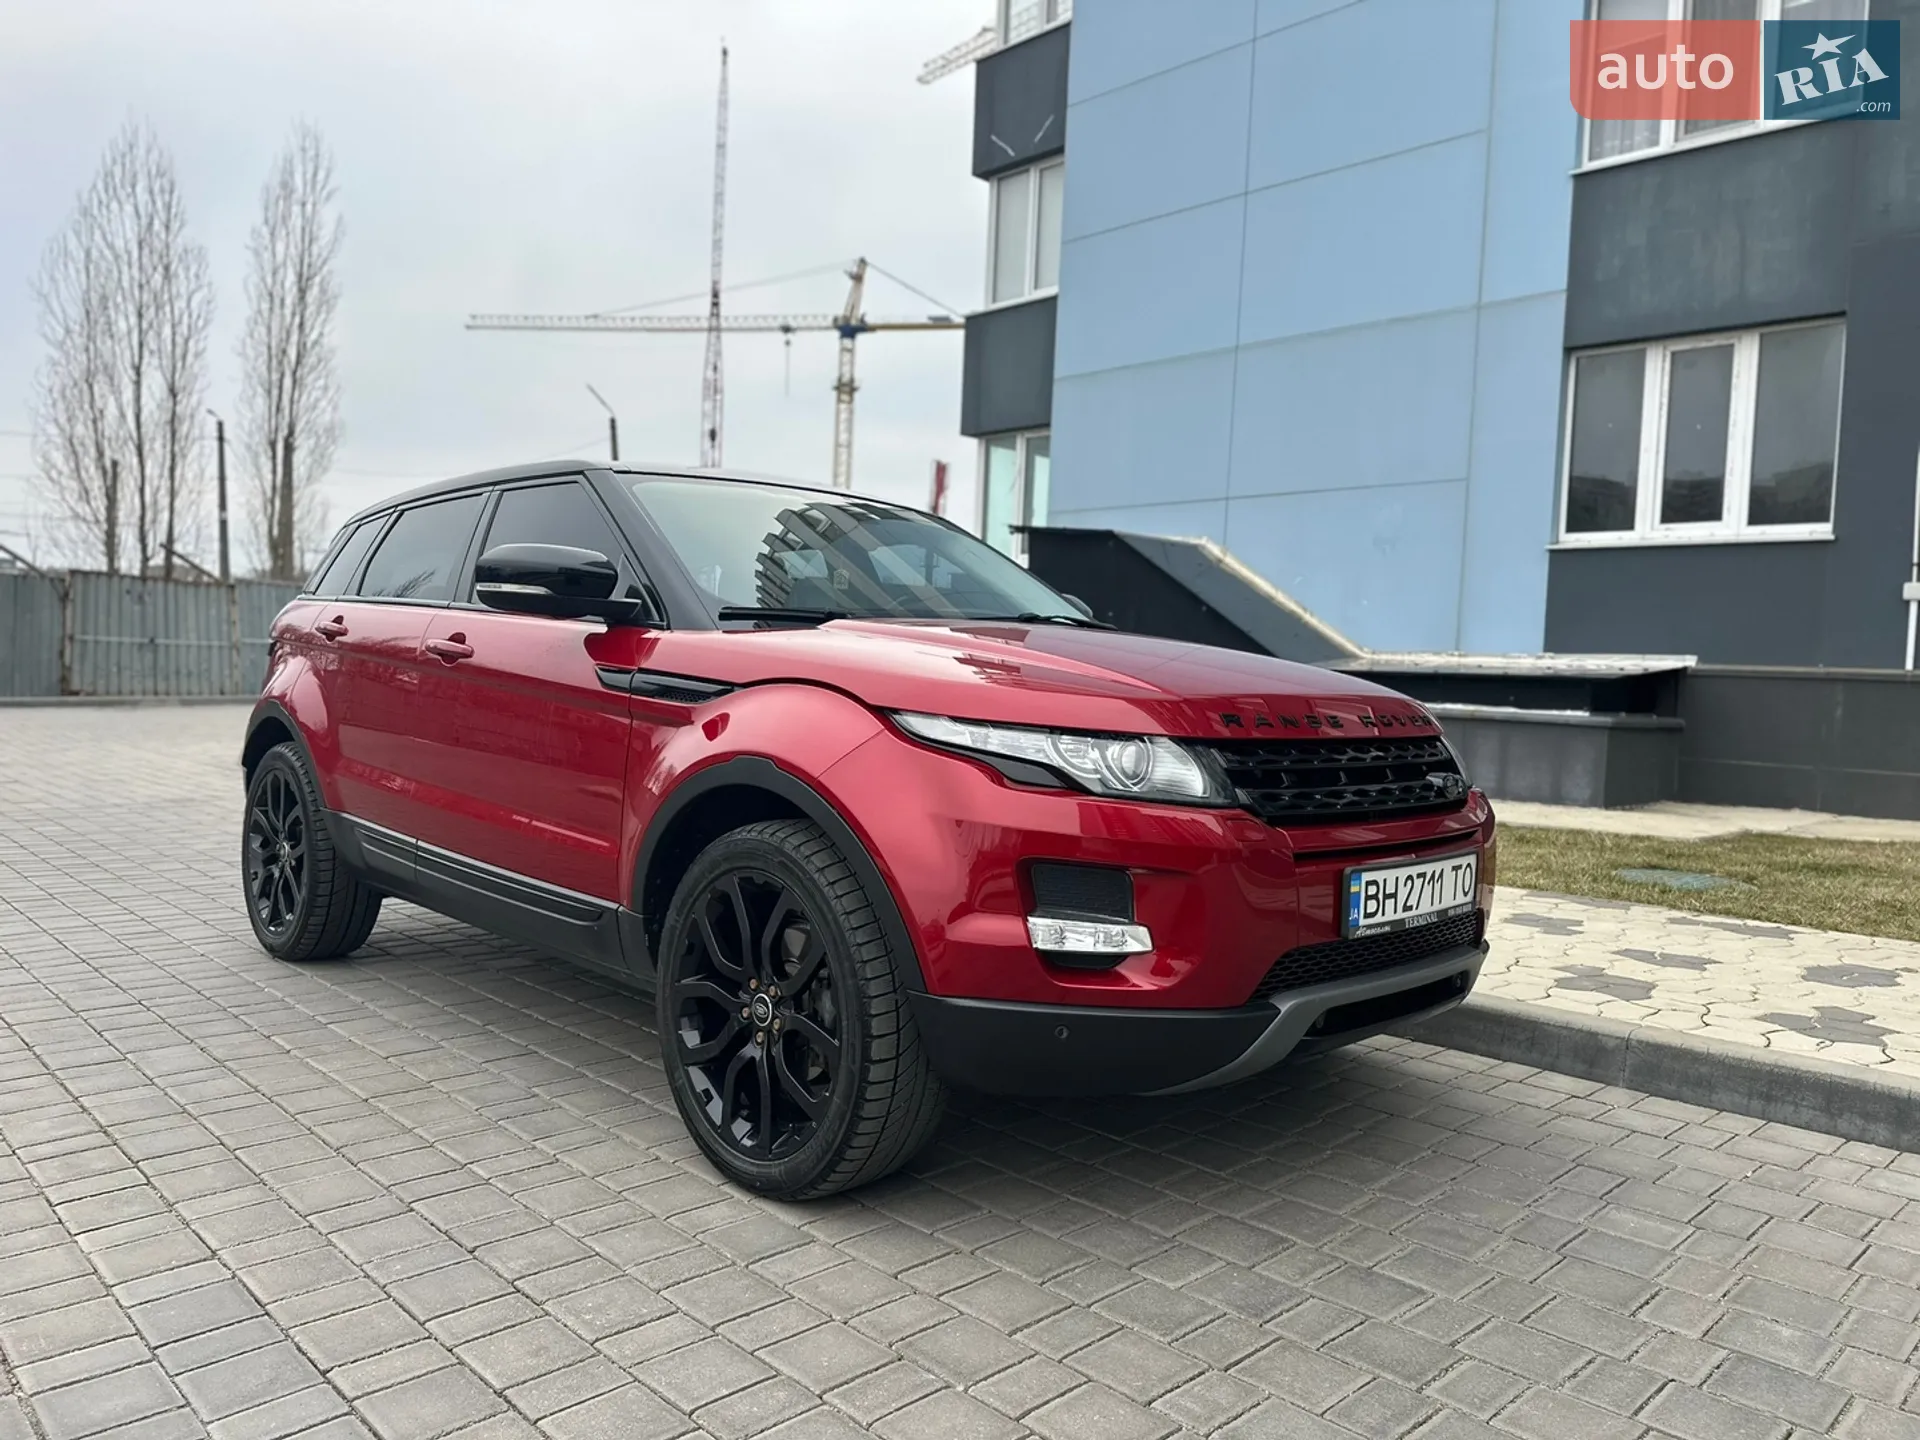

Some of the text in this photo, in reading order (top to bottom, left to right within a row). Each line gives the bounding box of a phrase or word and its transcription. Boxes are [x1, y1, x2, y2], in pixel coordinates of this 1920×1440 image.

[1218, 712, 1434, 729] RANGE ROVER
[1451, 862, 1474, 901] TO
[1404, 911, 1439, 928] TERMINAL
